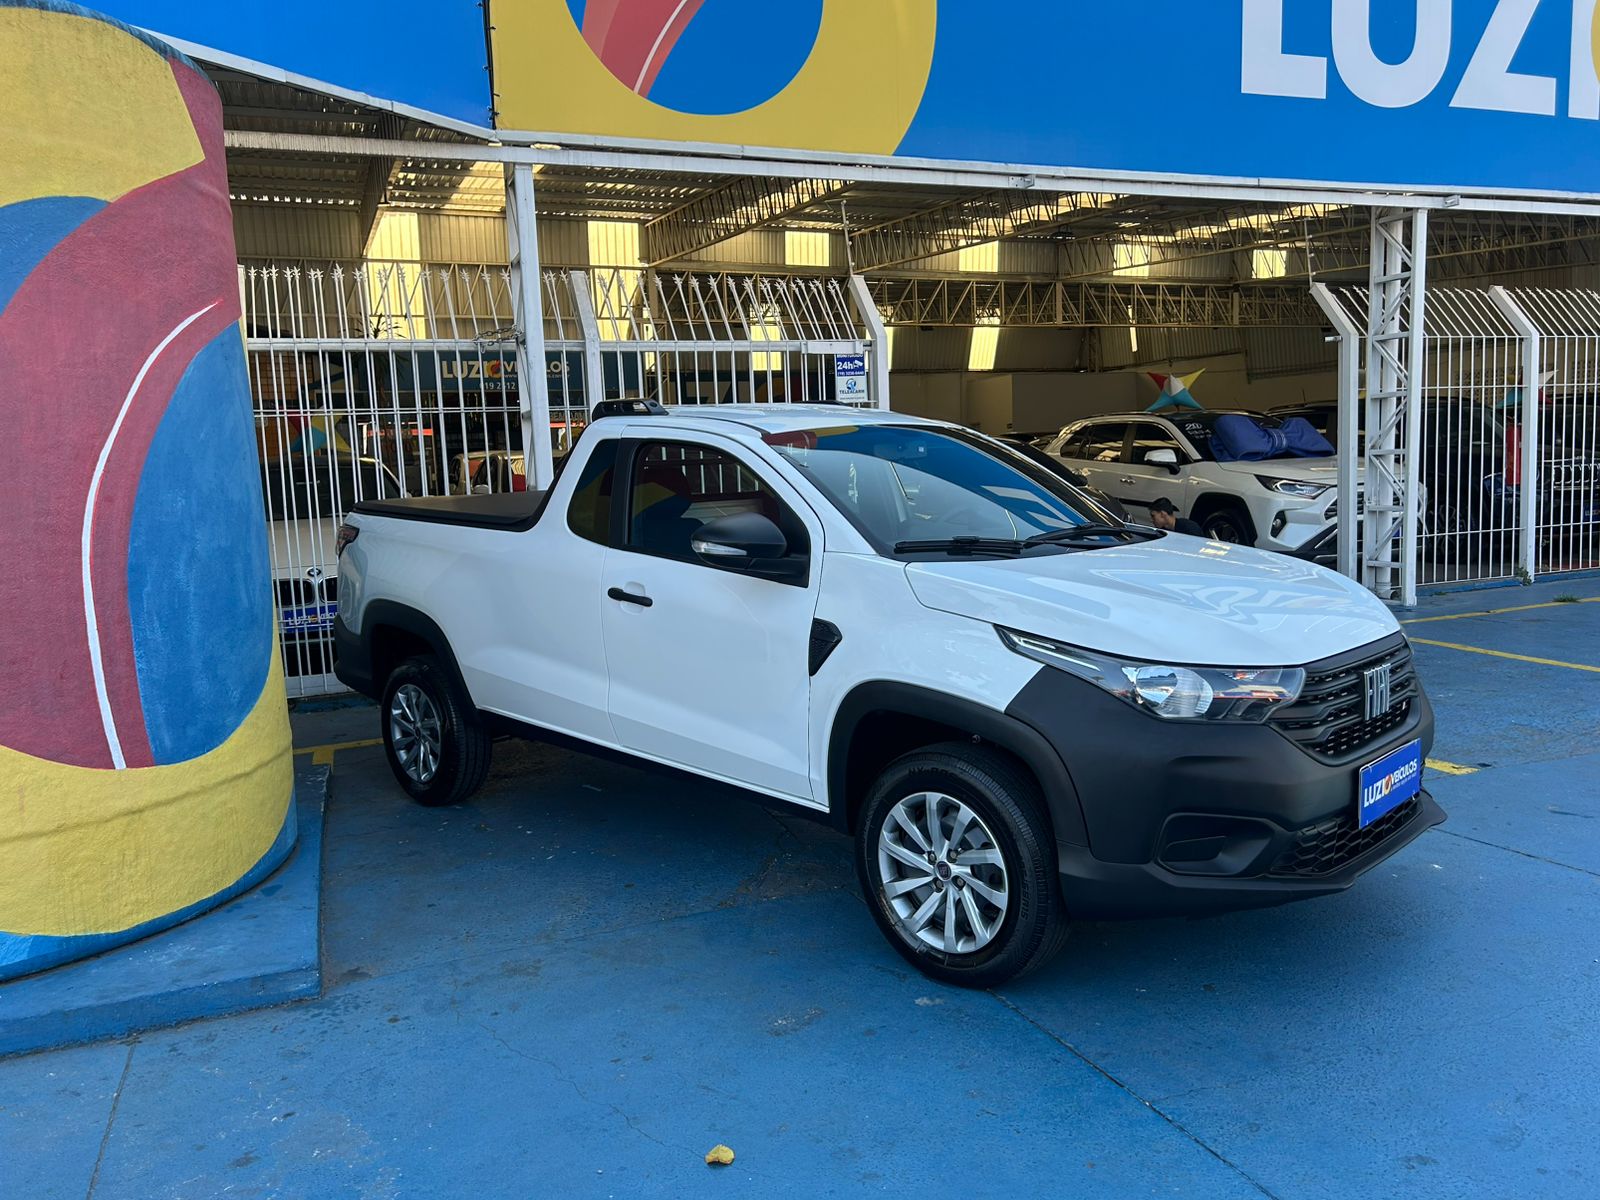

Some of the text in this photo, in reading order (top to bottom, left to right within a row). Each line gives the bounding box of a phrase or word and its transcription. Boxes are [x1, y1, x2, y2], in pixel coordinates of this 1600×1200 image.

[1241, 0, 1600, 119] LUZI
[1364, 663, 1391, 721] FIAT
[1364, 774, 1392, 808] LUZIO
